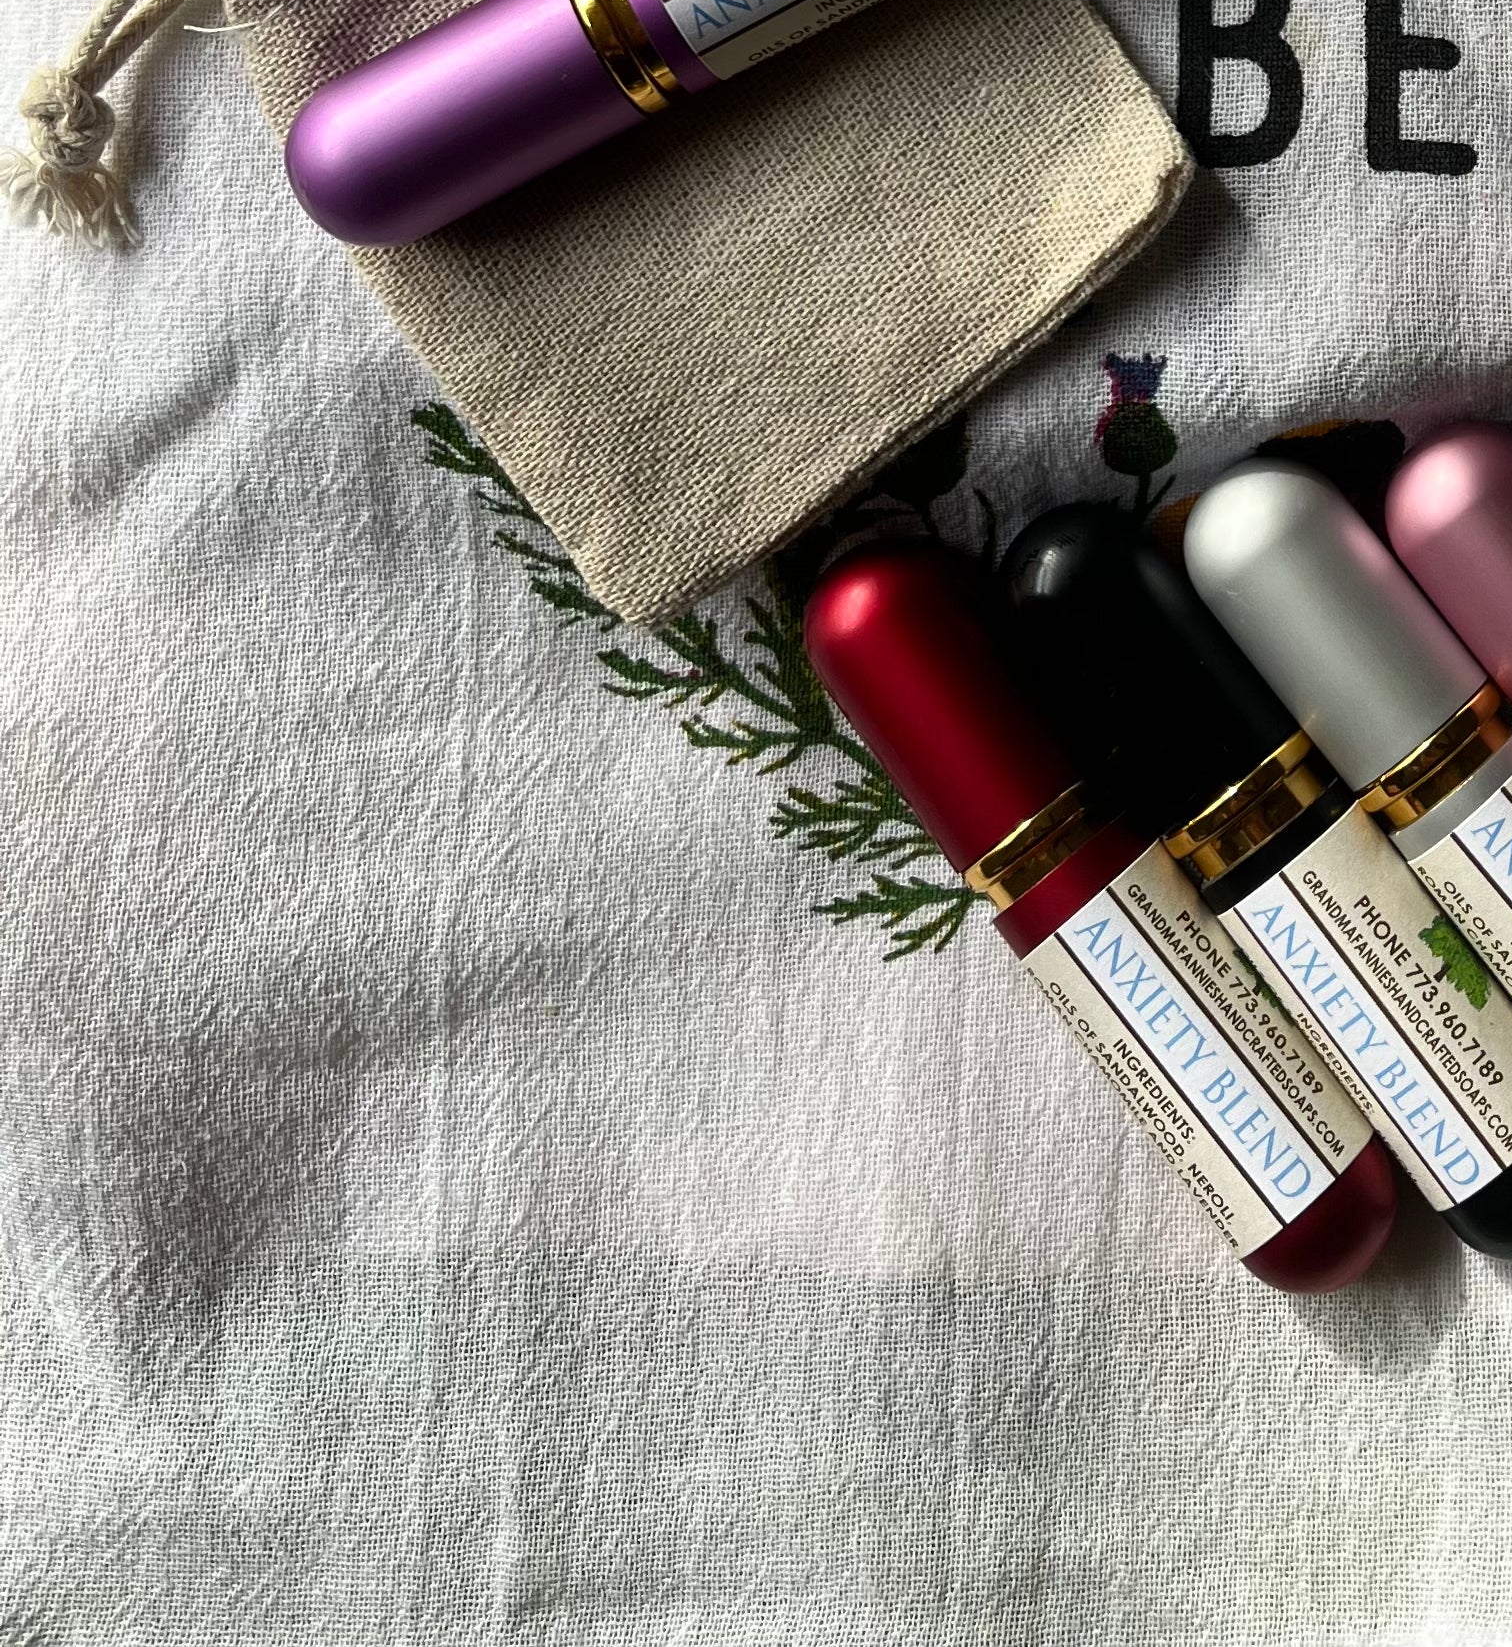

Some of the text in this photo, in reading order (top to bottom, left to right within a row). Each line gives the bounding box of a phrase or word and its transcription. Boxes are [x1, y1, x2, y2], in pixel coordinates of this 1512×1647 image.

[1354, 896, 1411, 966] PHONE
[1406, 964, 1505, 1086] 773.960.7189
[1417, 866, 1467, 928] ROMAN
[1442, 882, 1475, 916] OILS
[1473, 916, 1495, 940] OF
[1075, 917, 1312, 1199] ANXIETY BLEND
[1113, 1038, 1197, 1145] INGREDIENTS:
[1127, 884, 1346, 1157] GRANDMAFANNIESHANDCRAFTEDSOAPS.COM
[1175, 910, 1325, 1094] PHONE 773.960.7189
[1253, 904, 1388, 1057] ANXIETY
[1375, 1059, 1480, 1187] BLEND
[1050, 981, 1080, 1017] OILS
[1078, 1018, 1098, 1044] OF
[1187, 1163, 1236, 1227] NEROLI,
